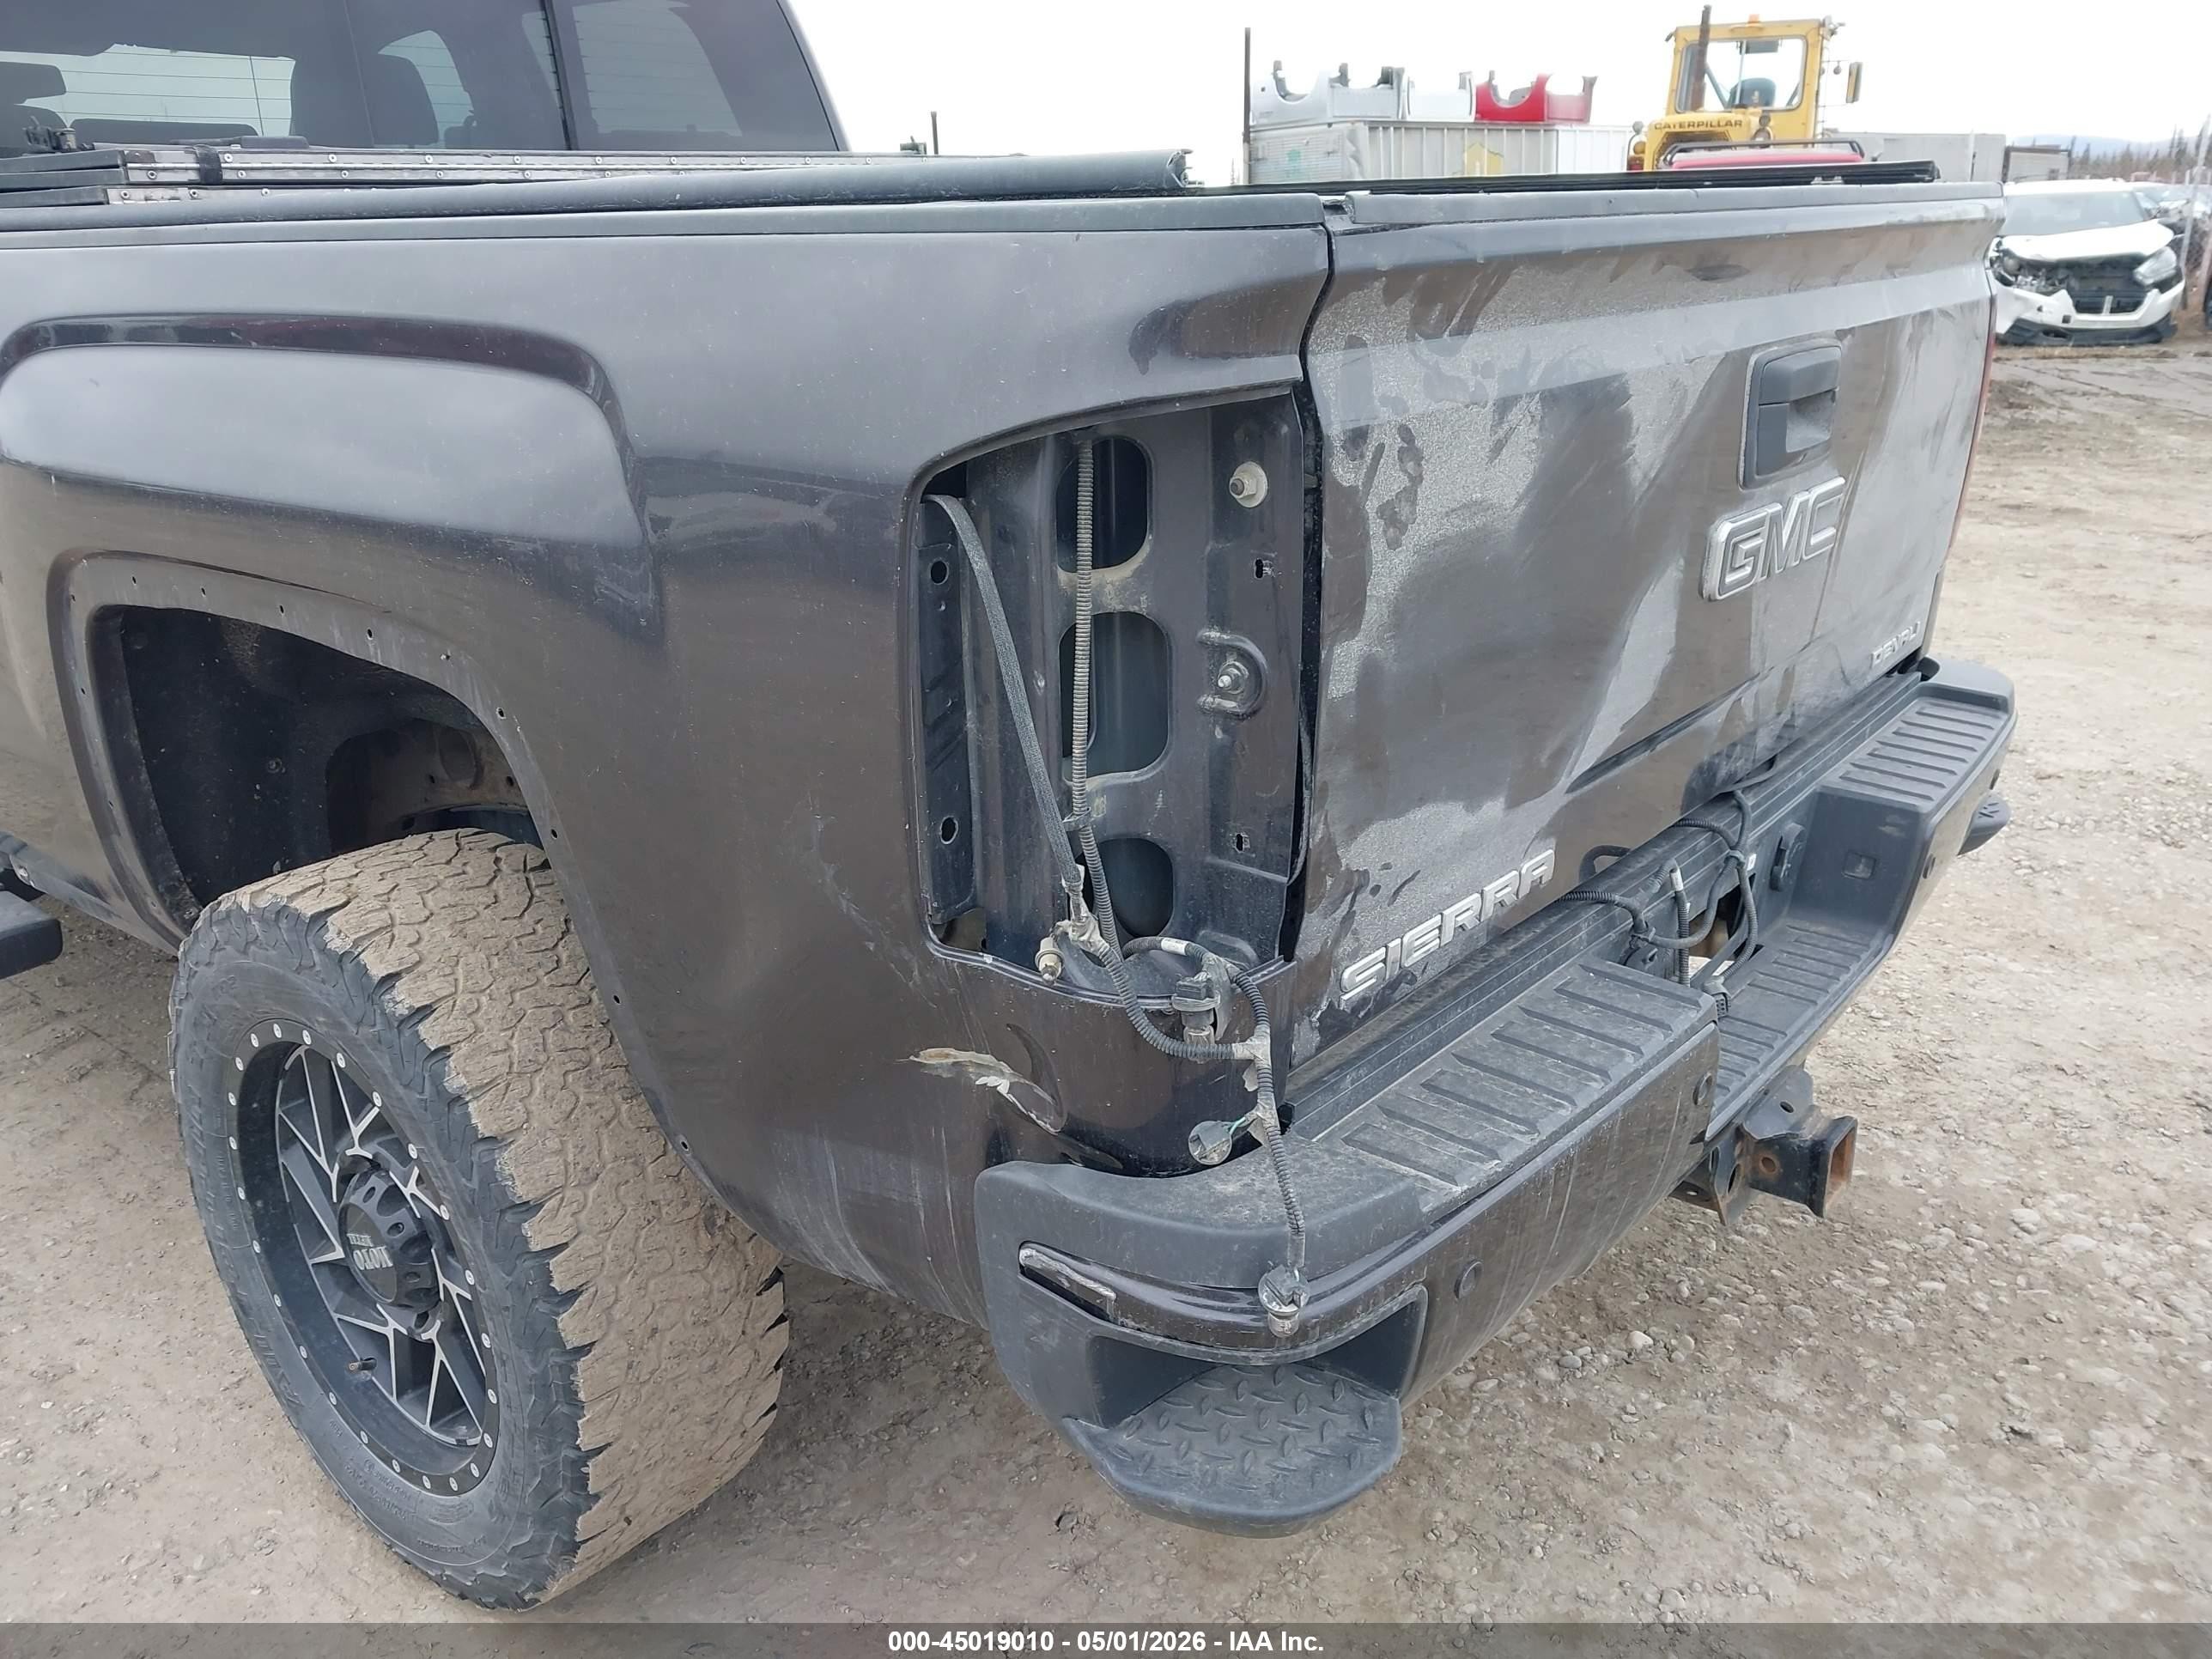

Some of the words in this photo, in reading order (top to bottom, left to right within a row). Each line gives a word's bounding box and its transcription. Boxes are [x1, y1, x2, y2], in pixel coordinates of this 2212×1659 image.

[1654, 119, 1743, 130] CATERPILLAR
[1701, 476, 1846, 601] GMC
[1339, 848, 1555, 1009] SIERRA
[353, 1246, 393, 1271] MOTO
